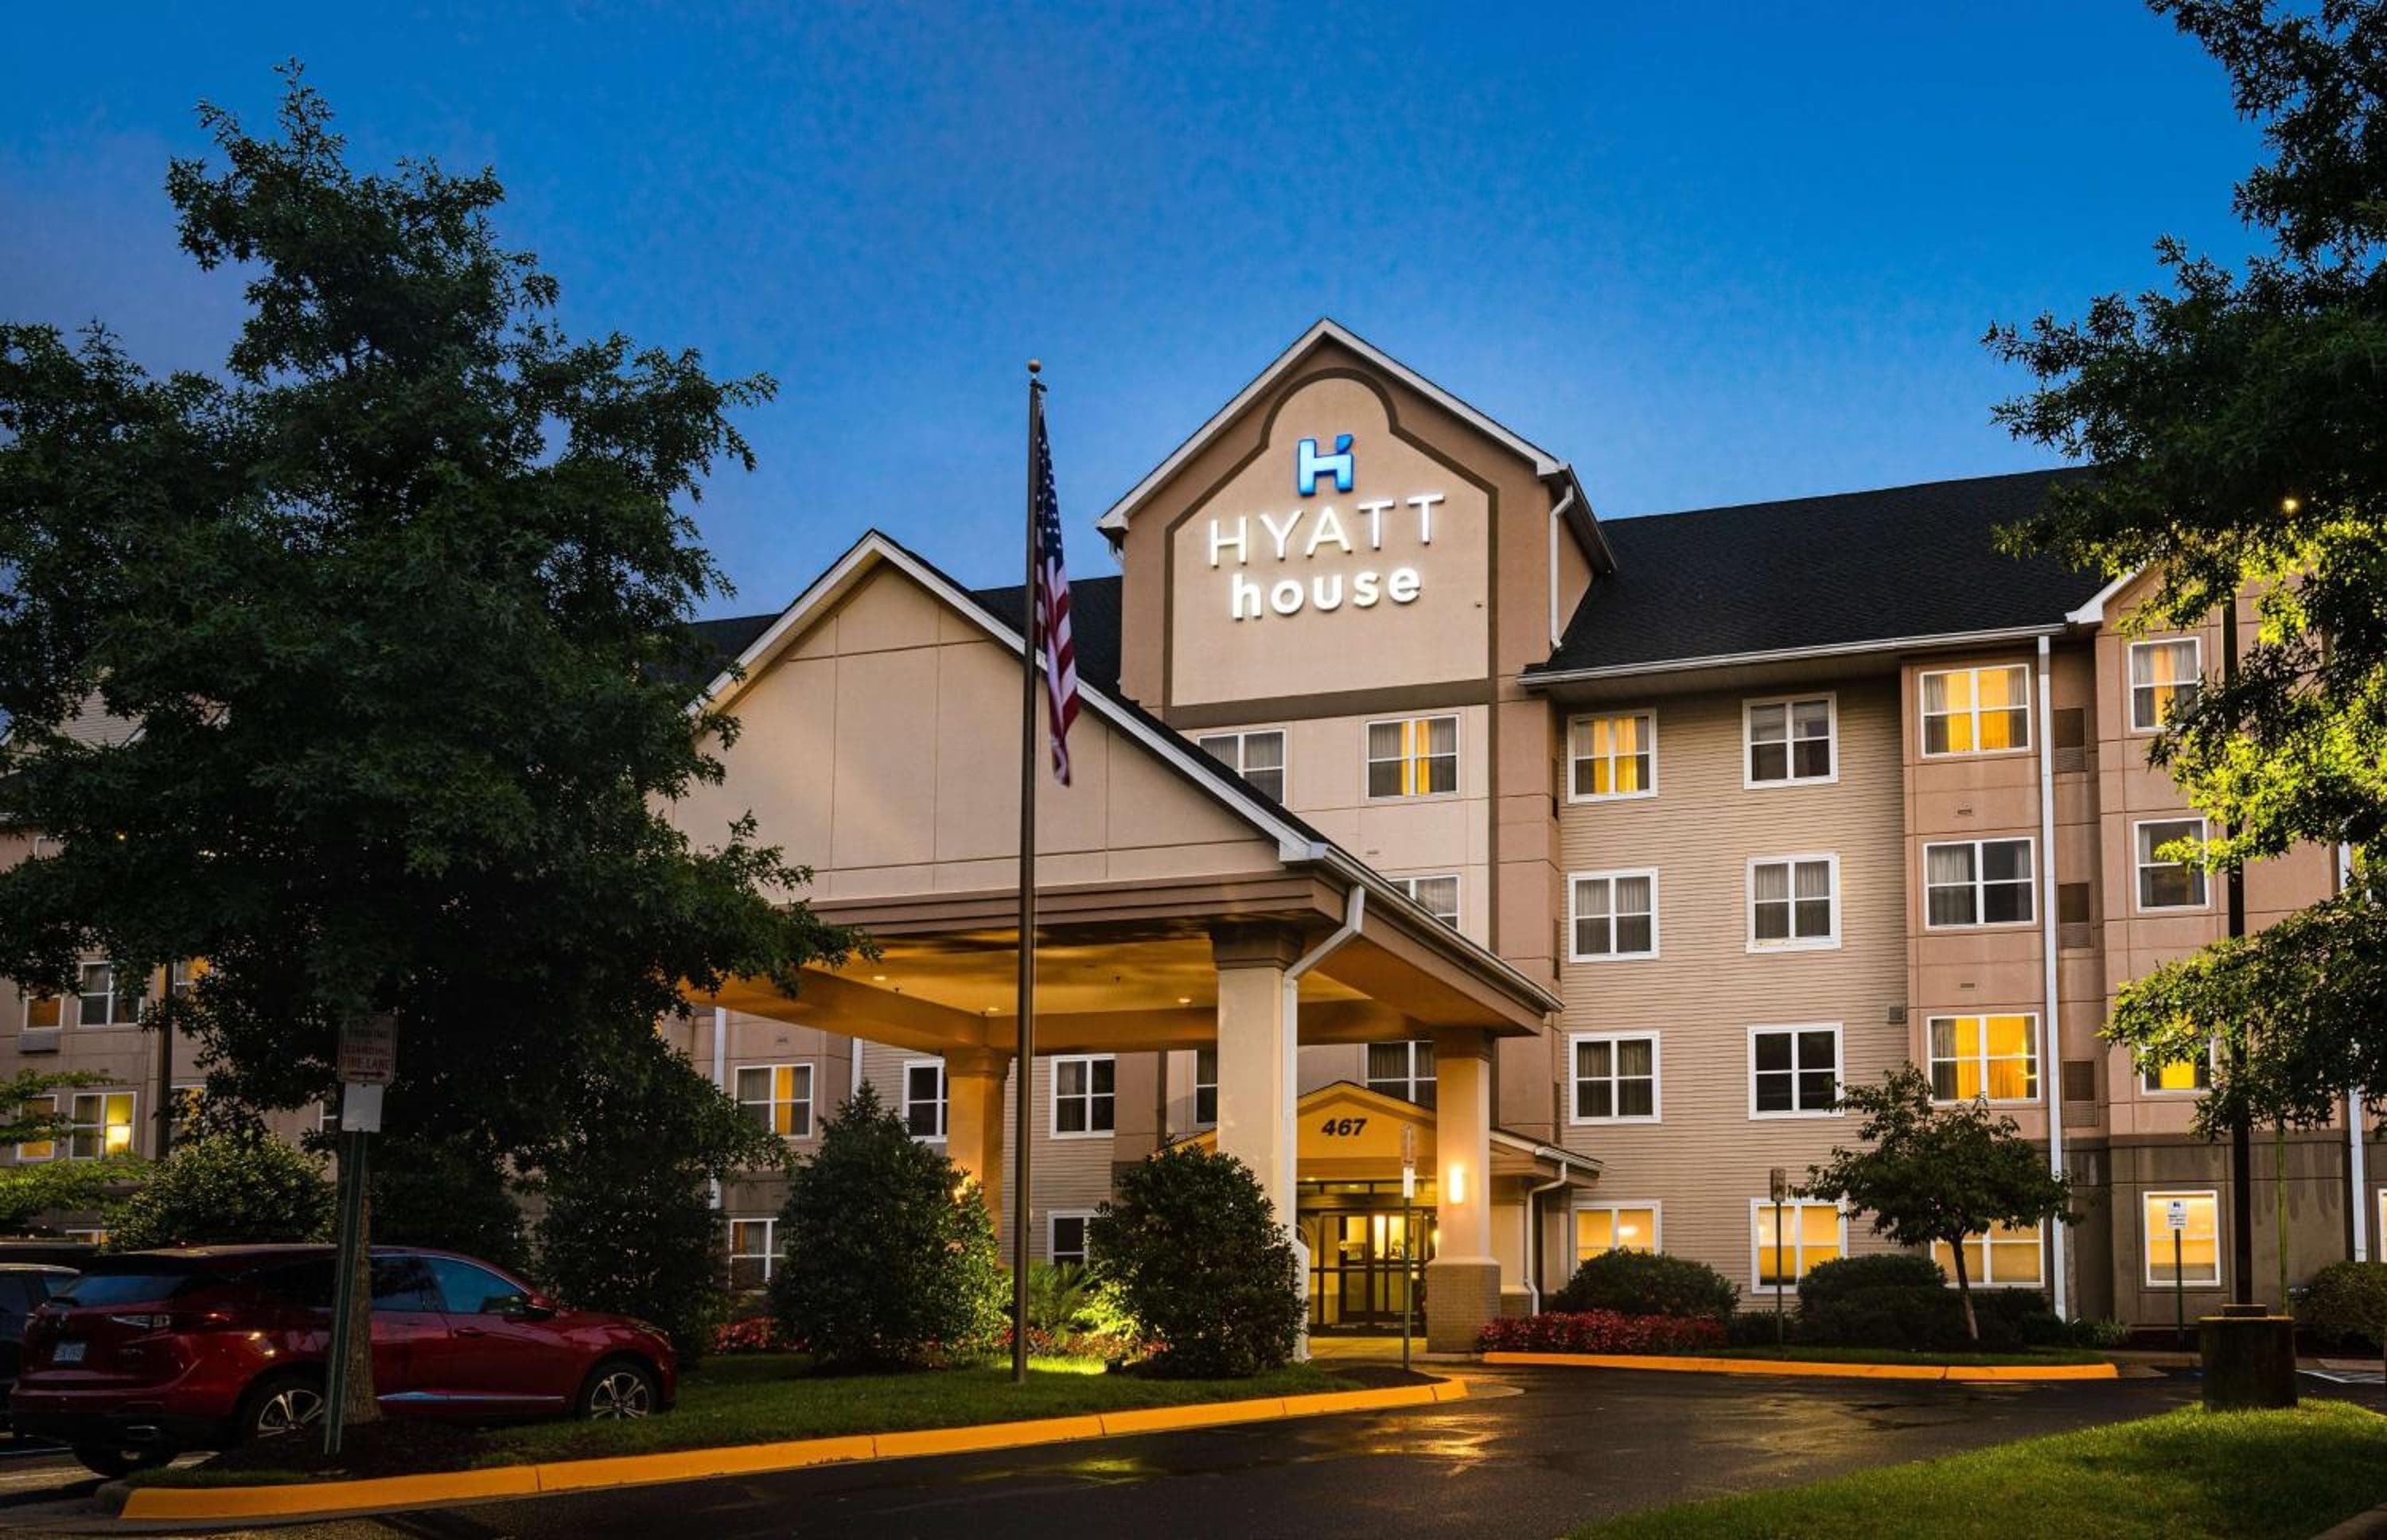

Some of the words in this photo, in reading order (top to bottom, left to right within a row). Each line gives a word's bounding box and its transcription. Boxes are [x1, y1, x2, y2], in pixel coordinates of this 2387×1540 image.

[1209, 494, 1445, 569] HYATT
[1232, 566, 1421, 620] house
[1321, 1118, 1367, 1136] 467
